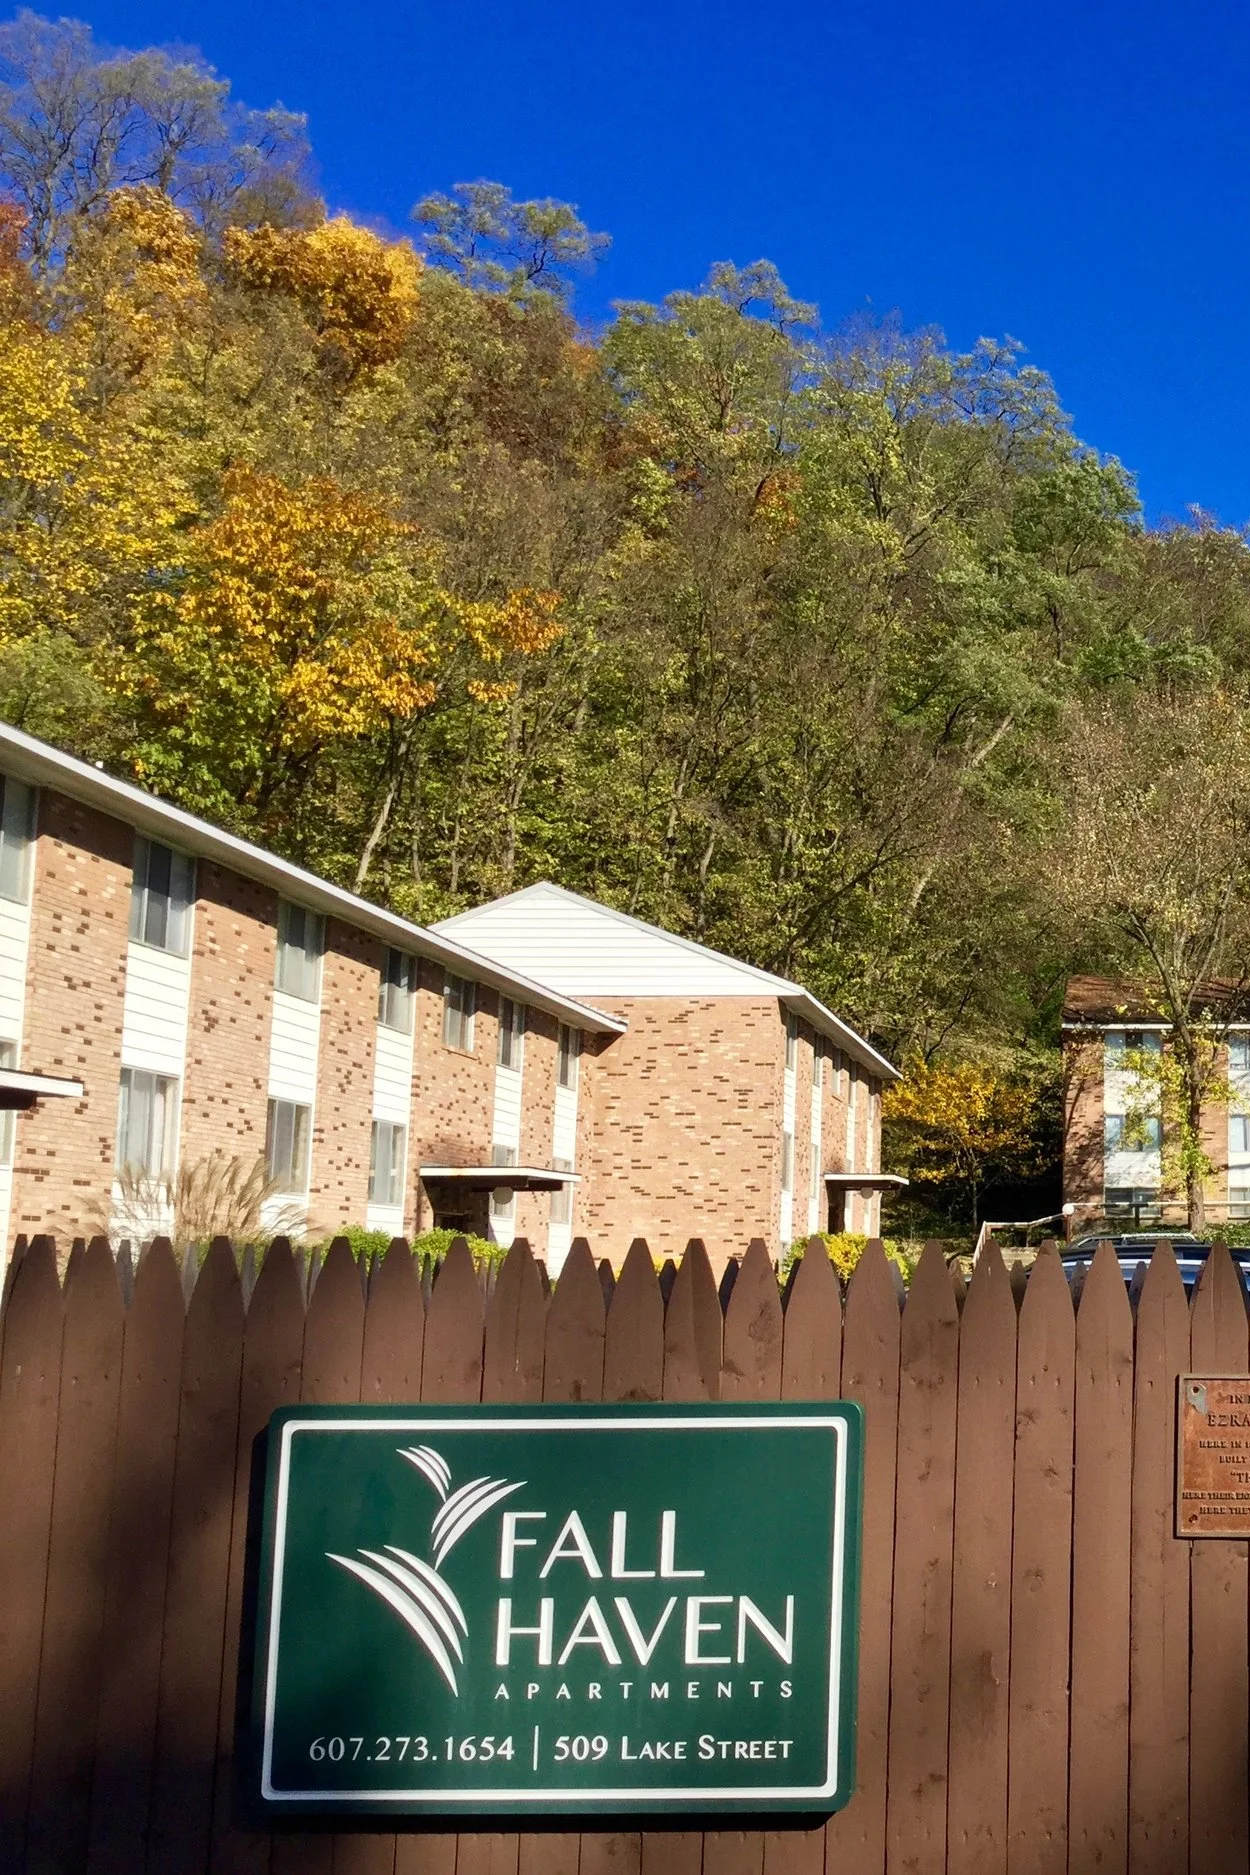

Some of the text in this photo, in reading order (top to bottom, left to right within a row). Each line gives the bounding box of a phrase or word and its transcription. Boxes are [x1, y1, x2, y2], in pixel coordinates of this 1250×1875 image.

[1229, 1394, 1243, 1404] IN
[1199, 1440, 1227, 1449] HERE
[1230, 1440, 1243, 1449] IN
[1219, 1455, 1248, 1464] BUILT
[1182, 1491, 1206, 1500] HERE
[1207, 1491, 1235, 1500] THEIR
[1199, 1506, 1226, 1515] HERE
[499, 1510, 706, 1579] FALL
[495, 1594, 795, 1666] HAVEN
[494, 1680, 793, 1700] APARTMENTS
[308, 1735, 516, 1762] 607.273.1654
[553, 1735, 609, 1761] 509
